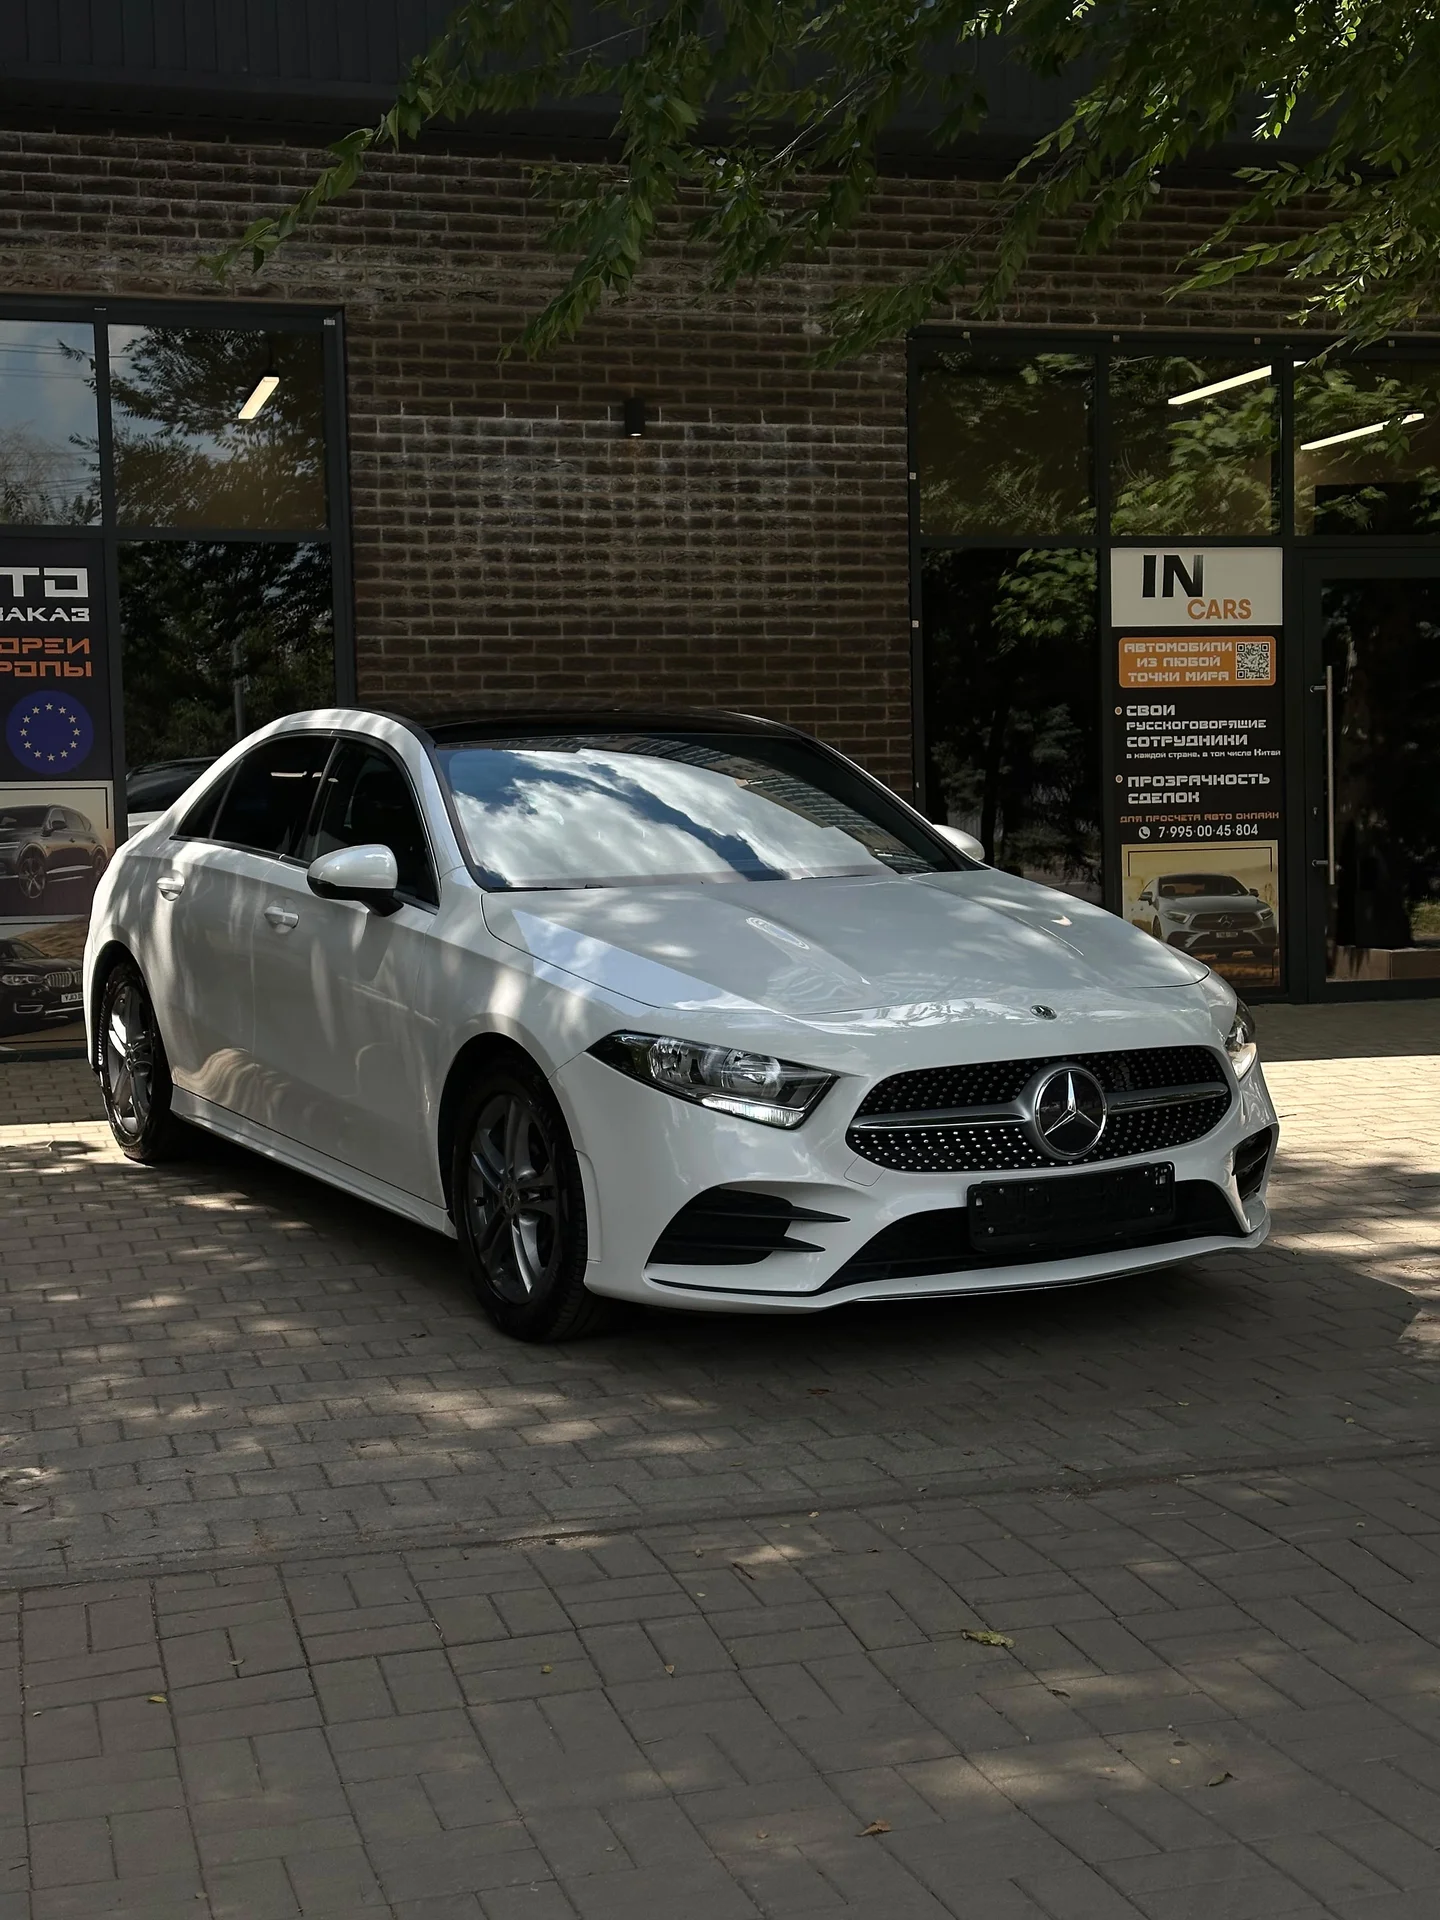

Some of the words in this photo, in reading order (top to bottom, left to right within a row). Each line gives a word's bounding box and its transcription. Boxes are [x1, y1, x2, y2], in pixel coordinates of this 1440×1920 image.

[1142, 554, 1204, 598] IN
[0, 607, 90, 622] АКАЗ
[1187, 598, 1252, 620] CARS
[1124, 642, 1232, 653] АВТОМОБИЛИ
[1136, 657, 1157, 668] ИЗ
[1163, 655, 1221, 668] ЛЮБОЙ
[1128, 672, 1180, 683] ТОЧКИ
[1186, 671, 1229, 682] МИРА
[1126, 704, 1176, 717] СВОИ
[1126, 734, 1248, 748] СОТРУДНИКИ
[1134, 751, 1166, 760] каждой
[1254, 748, 1281, 757] Китай
[1127, 773, 1271, 788] ПРОЗРАЧНОСТЬ
[1127, 791, 1200, 805] СДЕЛОК
[1120, 815, 1142, 824] ДЛЯ
[1145, 813, 1201, 823] ПРОСЧЕТА
[1204, 812, 1232, 821] АВТО
[1236, 810, 1279, 820] ОНЛАЙН
